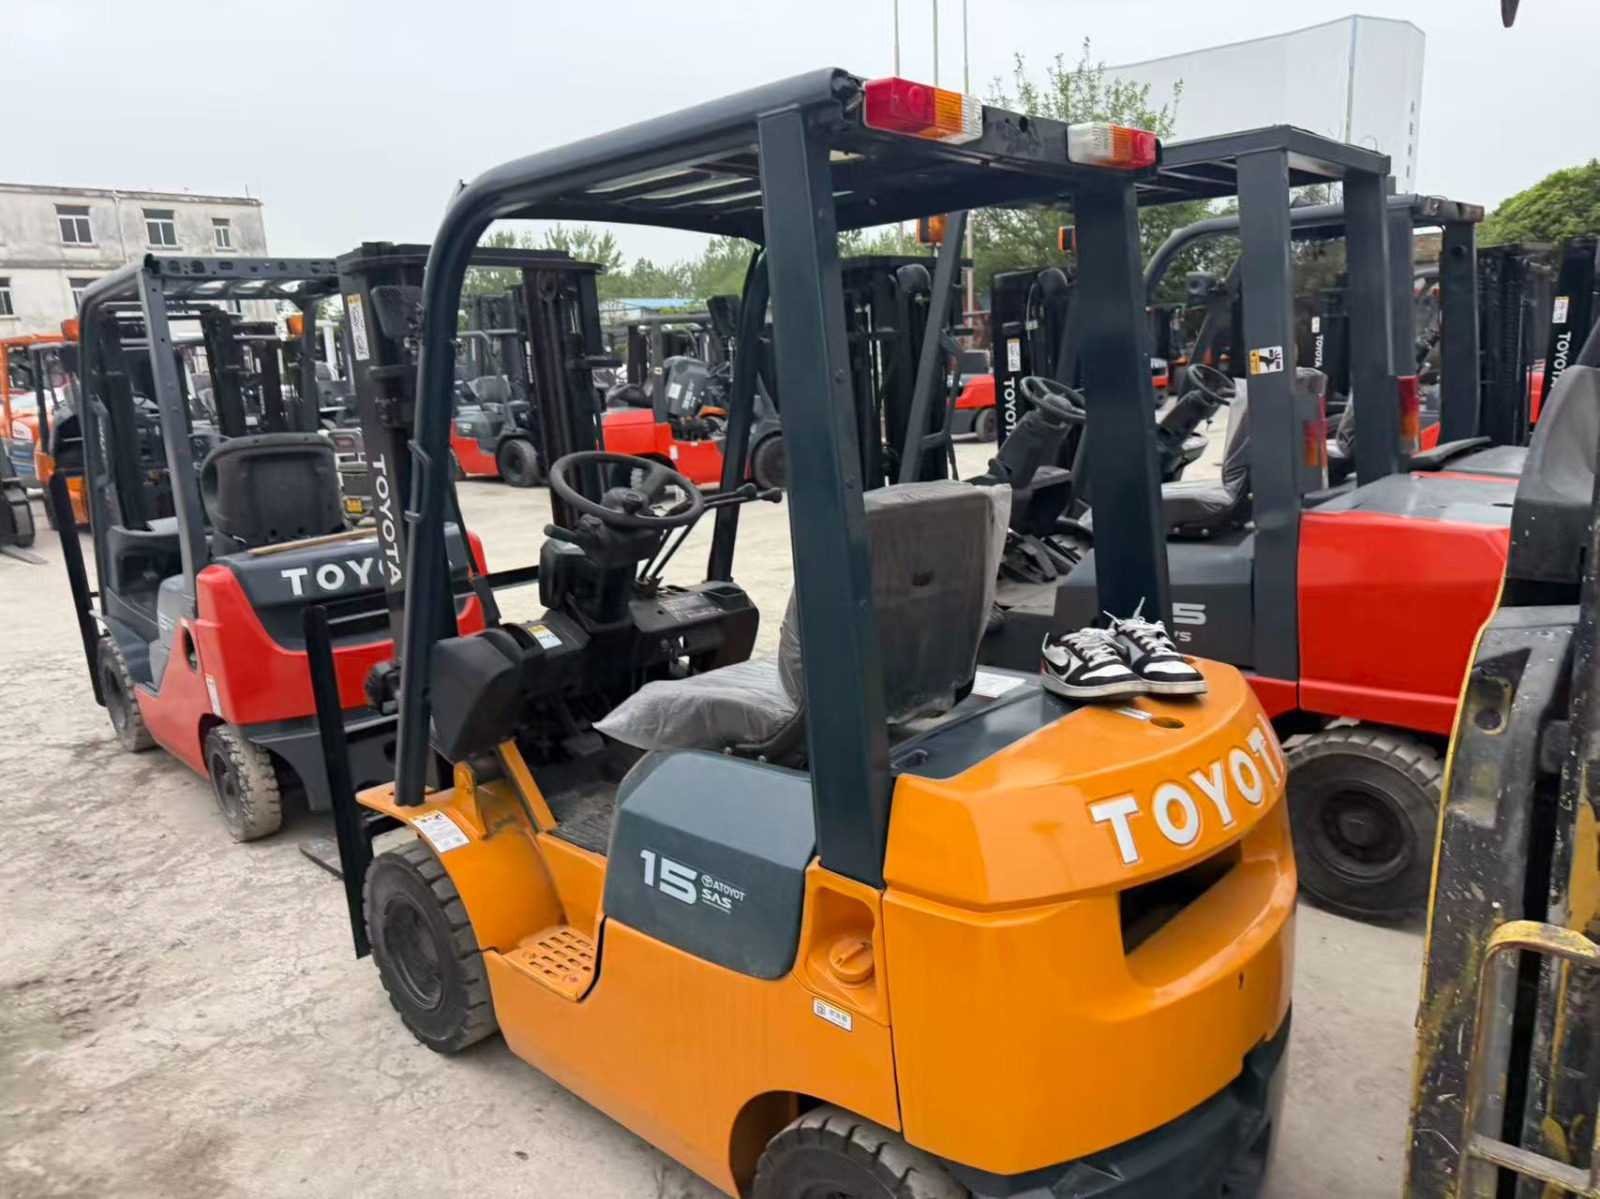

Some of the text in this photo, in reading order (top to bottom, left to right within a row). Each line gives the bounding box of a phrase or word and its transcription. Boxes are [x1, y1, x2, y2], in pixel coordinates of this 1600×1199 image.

[1003, 377, 1017, 436] TOYOT
[372, 453, 403, 586] TOYOTA
[281, 557, 385, 596] TOY
[1172, 602, 1206, 625] 5
[1089, 713, 1284, 865] TOYOT
[640, 849, 747, 905] 15 ATOYOT
[701, 888, 732, 909] SAS
